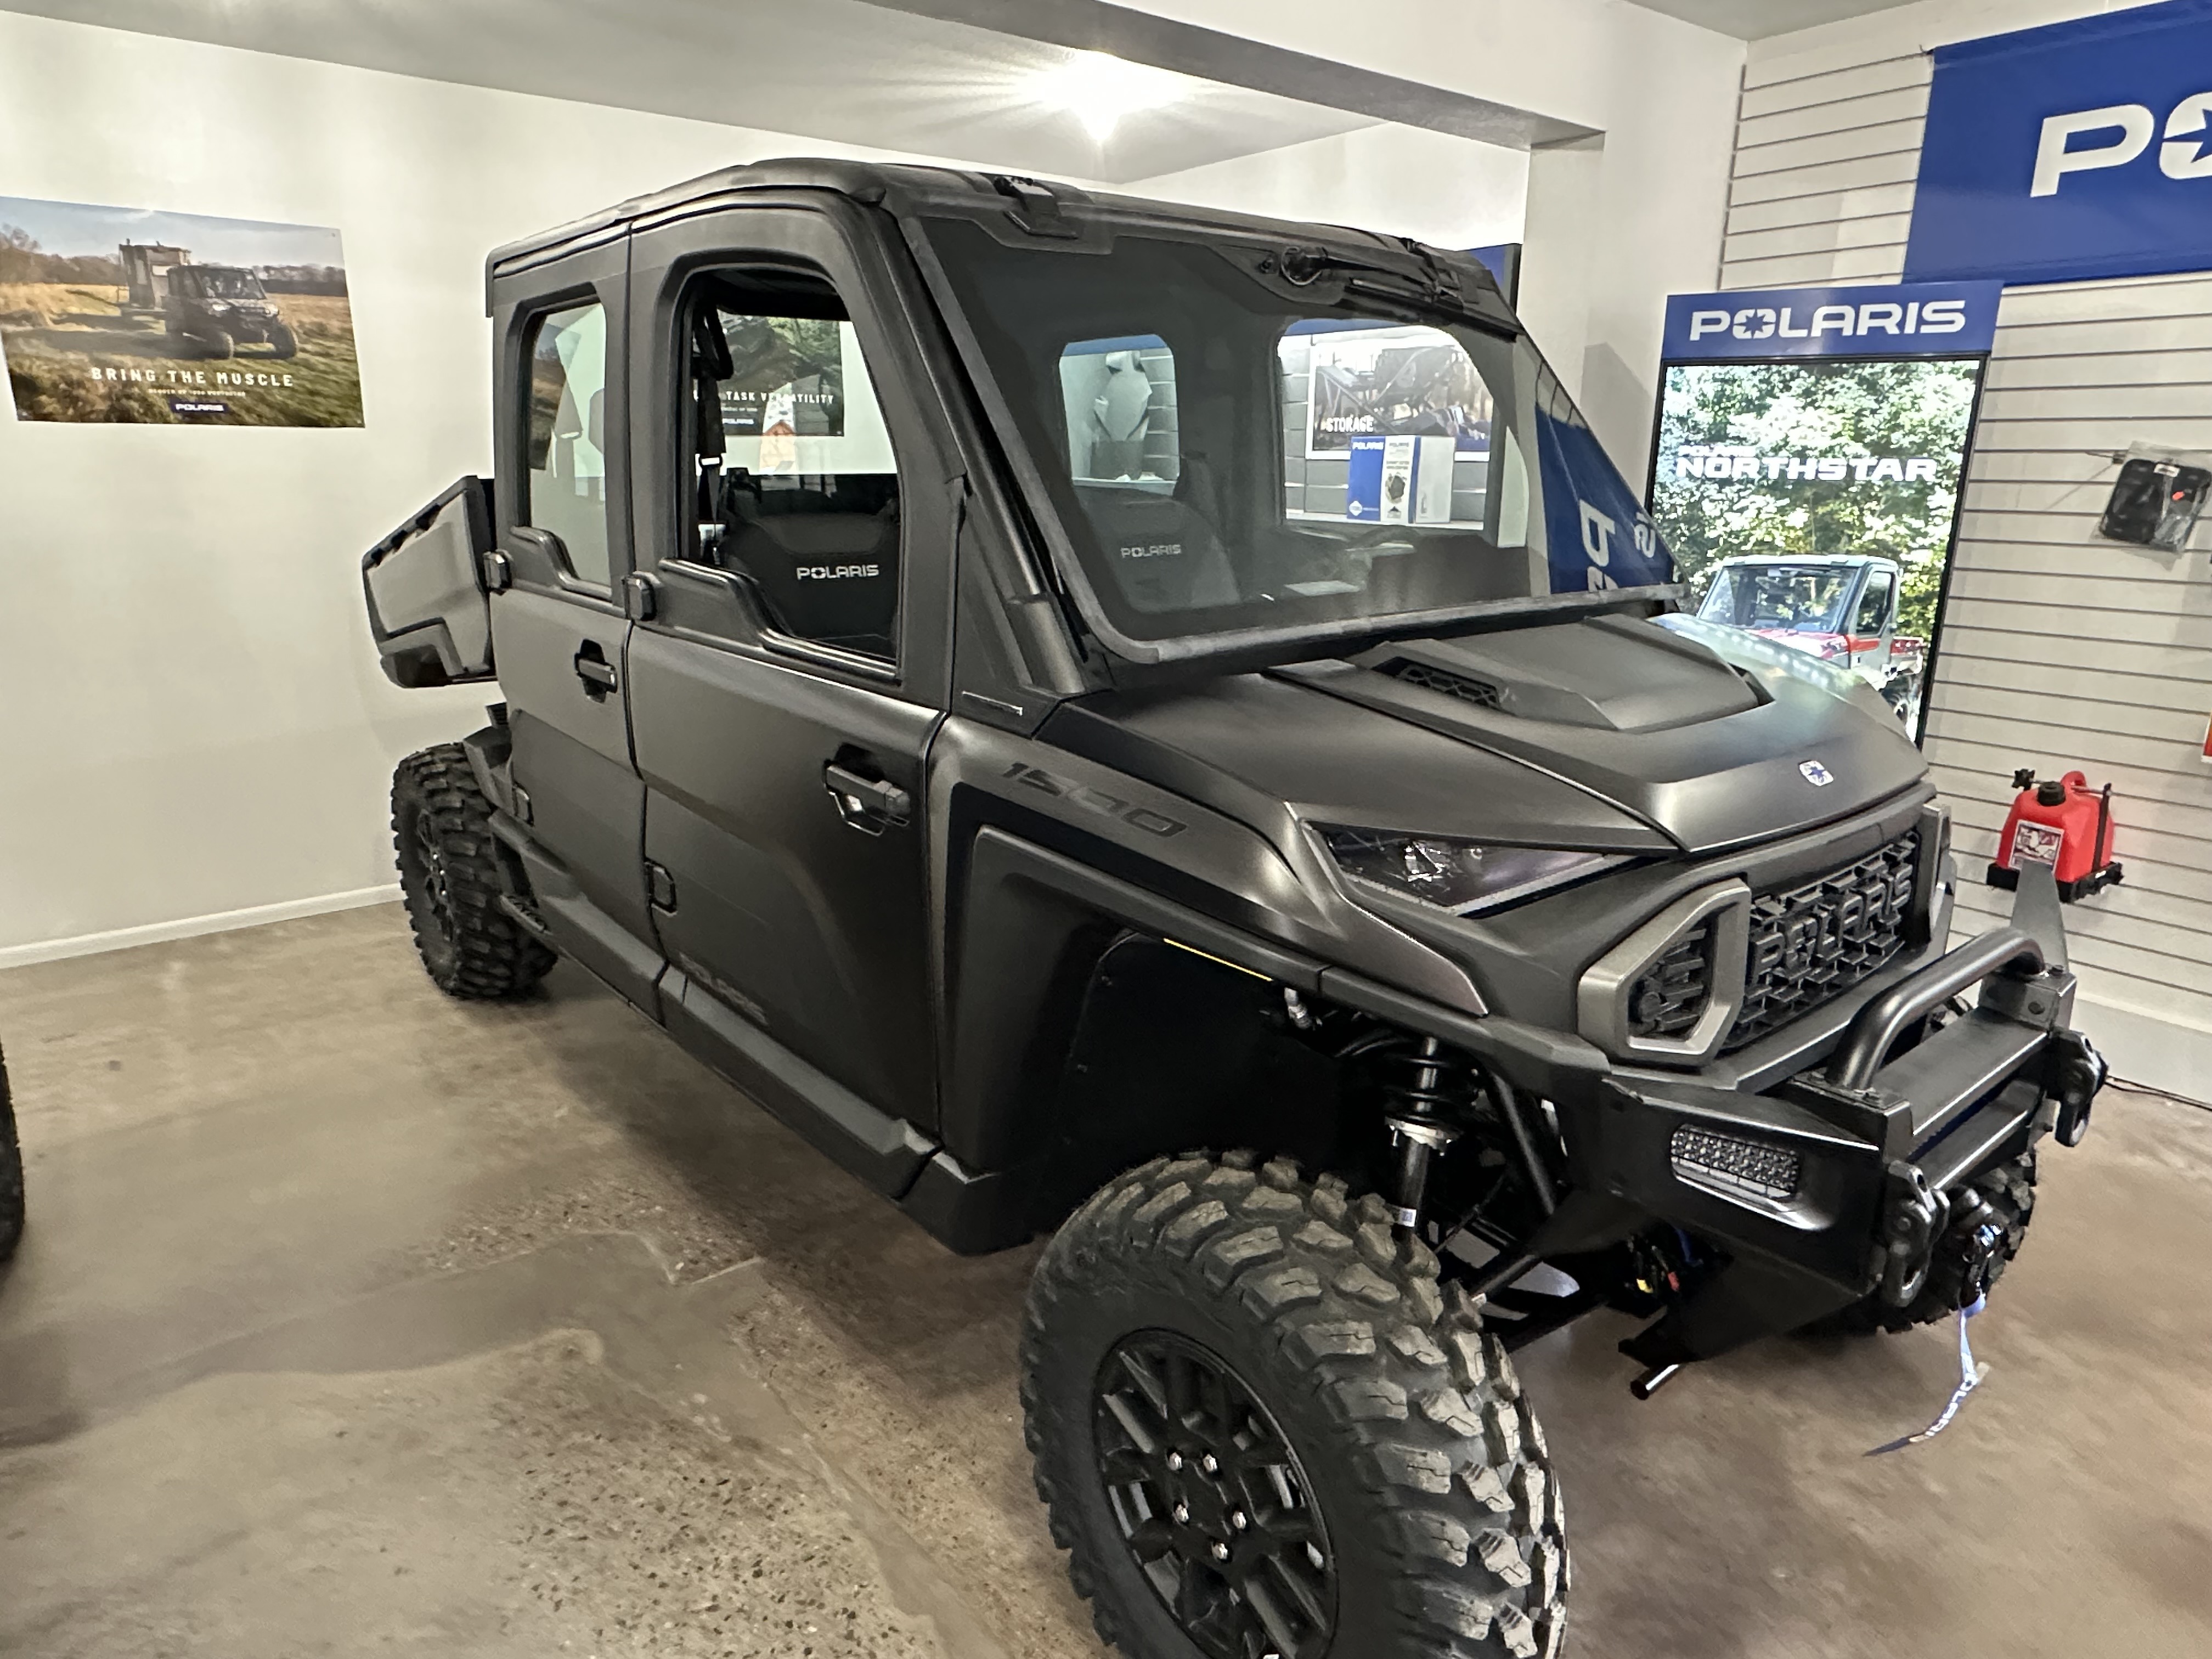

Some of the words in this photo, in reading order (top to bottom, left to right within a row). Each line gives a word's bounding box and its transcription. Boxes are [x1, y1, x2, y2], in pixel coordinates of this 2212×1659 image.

[1689, 300, 1966, 341] POLARIS
[91, 367, 156, 382] BRING
[167, 370, 206, 383] THE
[217, 372, 293, 386] MUSCLE
[726, 391, 755, 401] TASK
[760, 393, 833, 404] VEATILITY
[1326, 415, 1374, 432] STORAGE
[1676, 456, 1938, 482] NORTHSTAR
[1120, 544, 1181, 558] POLARIS
[797, 565, 879, 580] POLARIS
[1002, 762, 1188, 838] 1500
[1753, 864, 1914, 982] POLARIS
